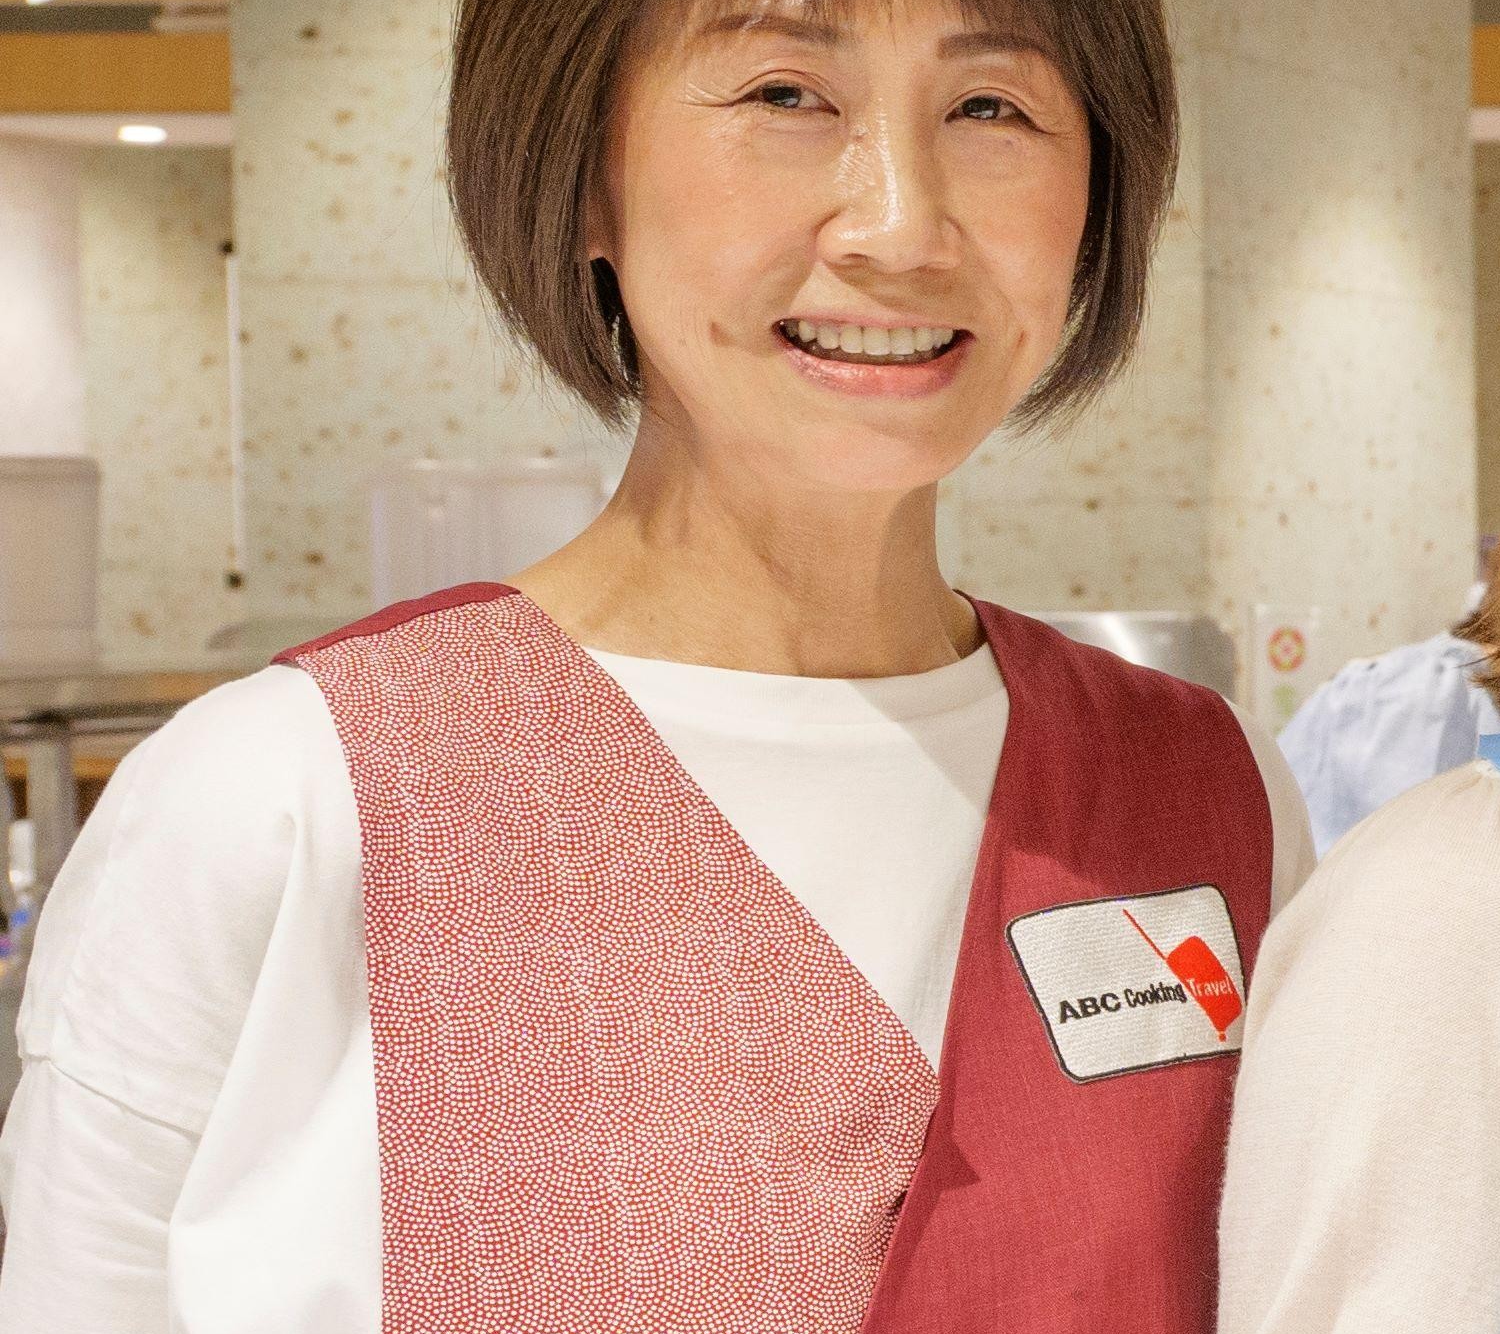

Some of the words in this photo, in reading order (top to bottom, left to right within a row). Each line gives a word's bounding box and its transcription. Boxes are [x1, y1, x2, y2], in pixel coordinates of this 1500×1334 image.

[1059, 992, 1122, 1024] ABC
[1123, 981, 1188, 1009] Cooking
[1186, 976, 1234, 998] Travel
